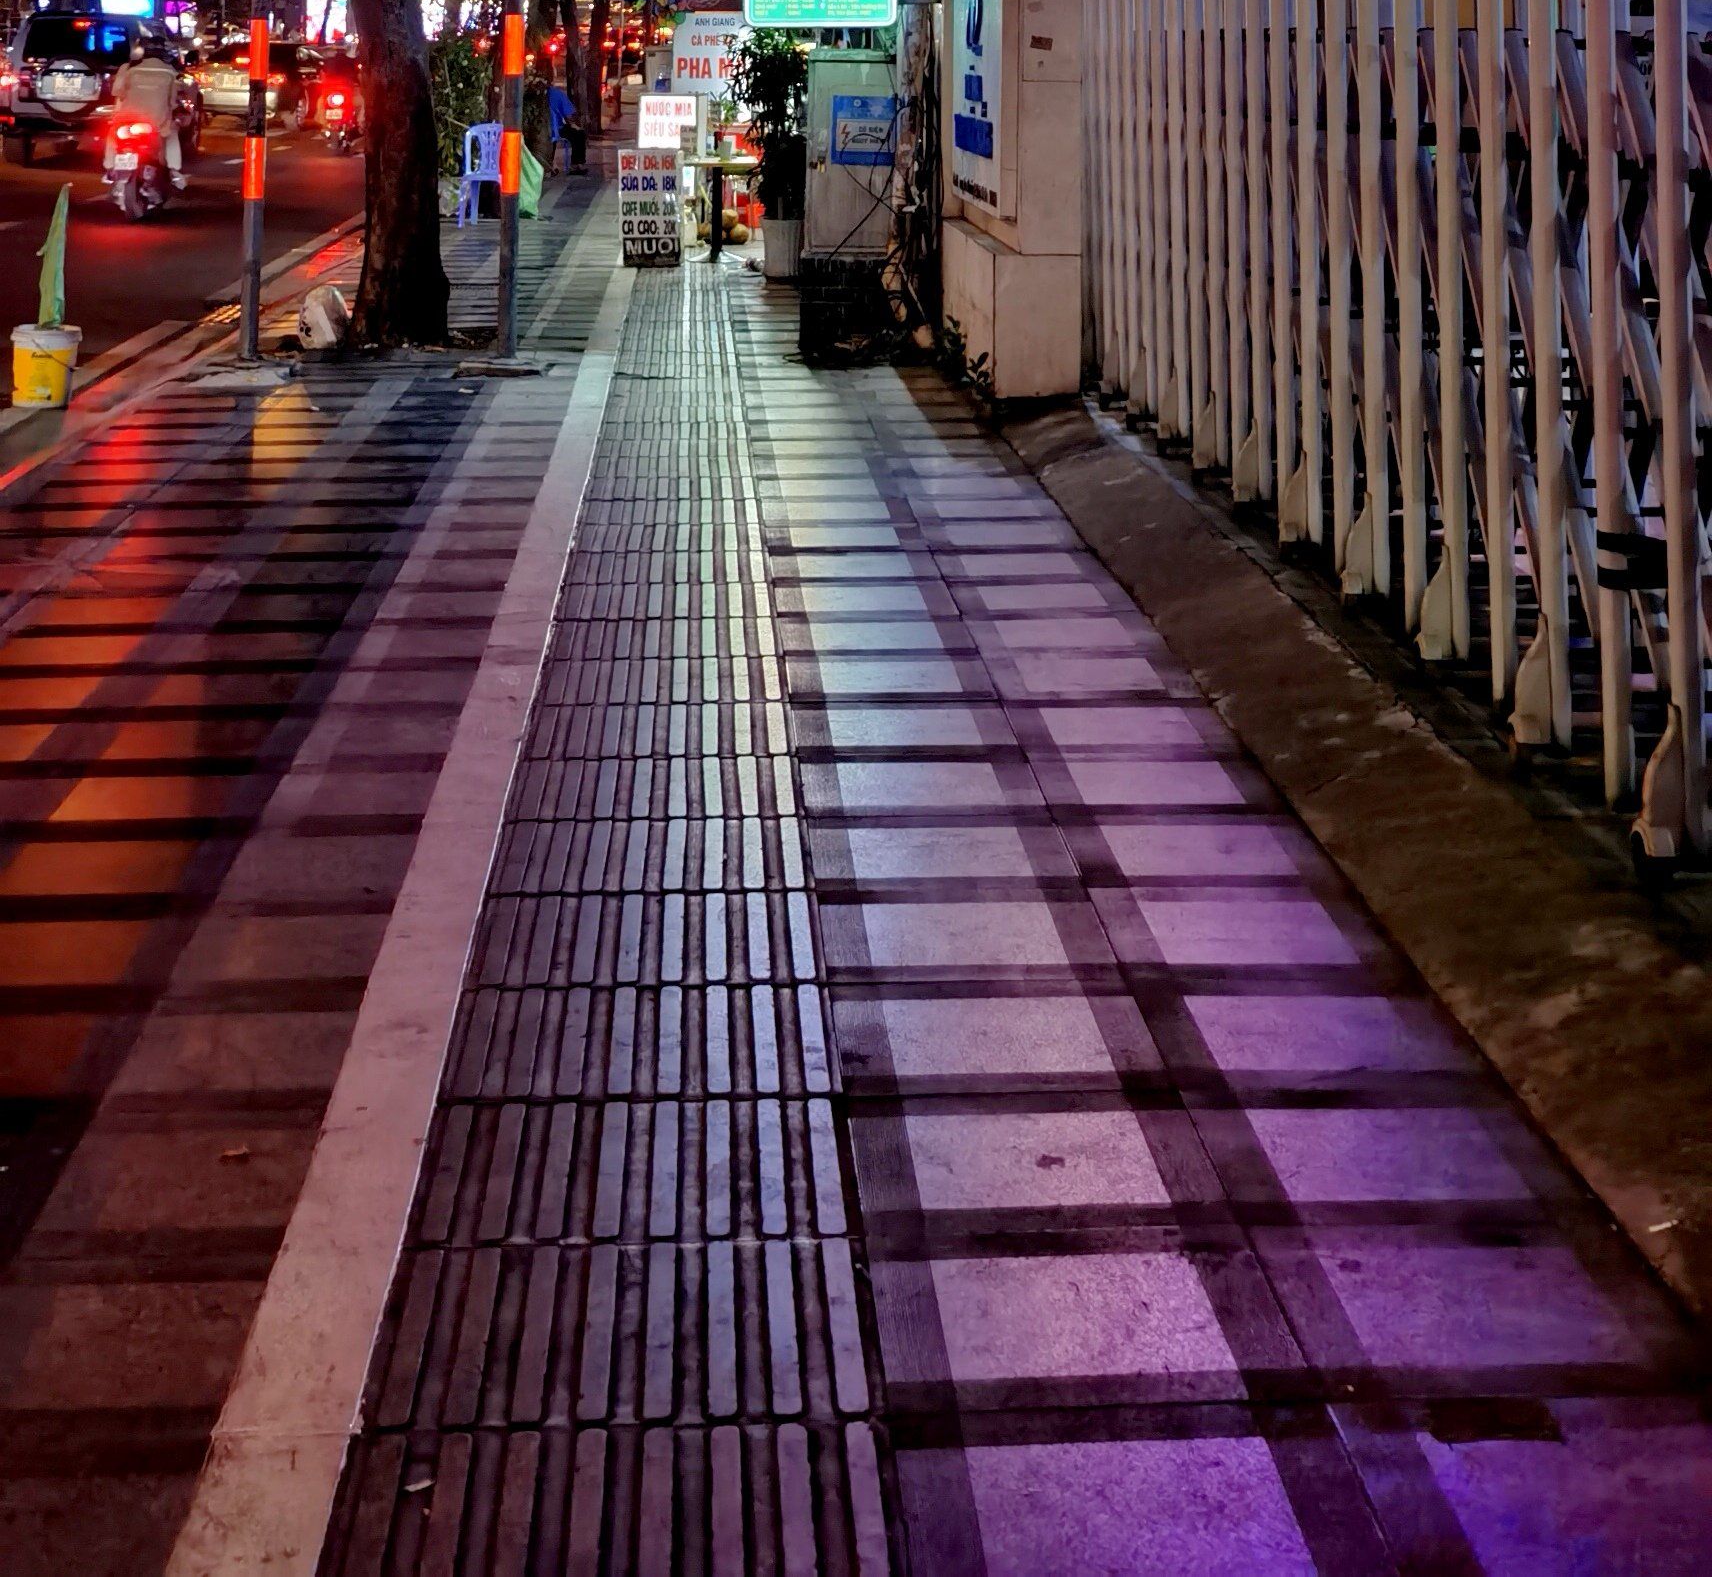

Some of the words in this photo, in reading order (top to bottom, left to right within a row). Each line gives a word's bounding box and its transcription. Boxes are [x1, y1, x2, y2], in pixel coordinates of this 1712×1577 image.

[695, 18, 710, 26] ANH
[712, 17, 735, 26] GIANG
[676, 57, 712, 79] PHA
[662, 176, 677, 191] 18K
